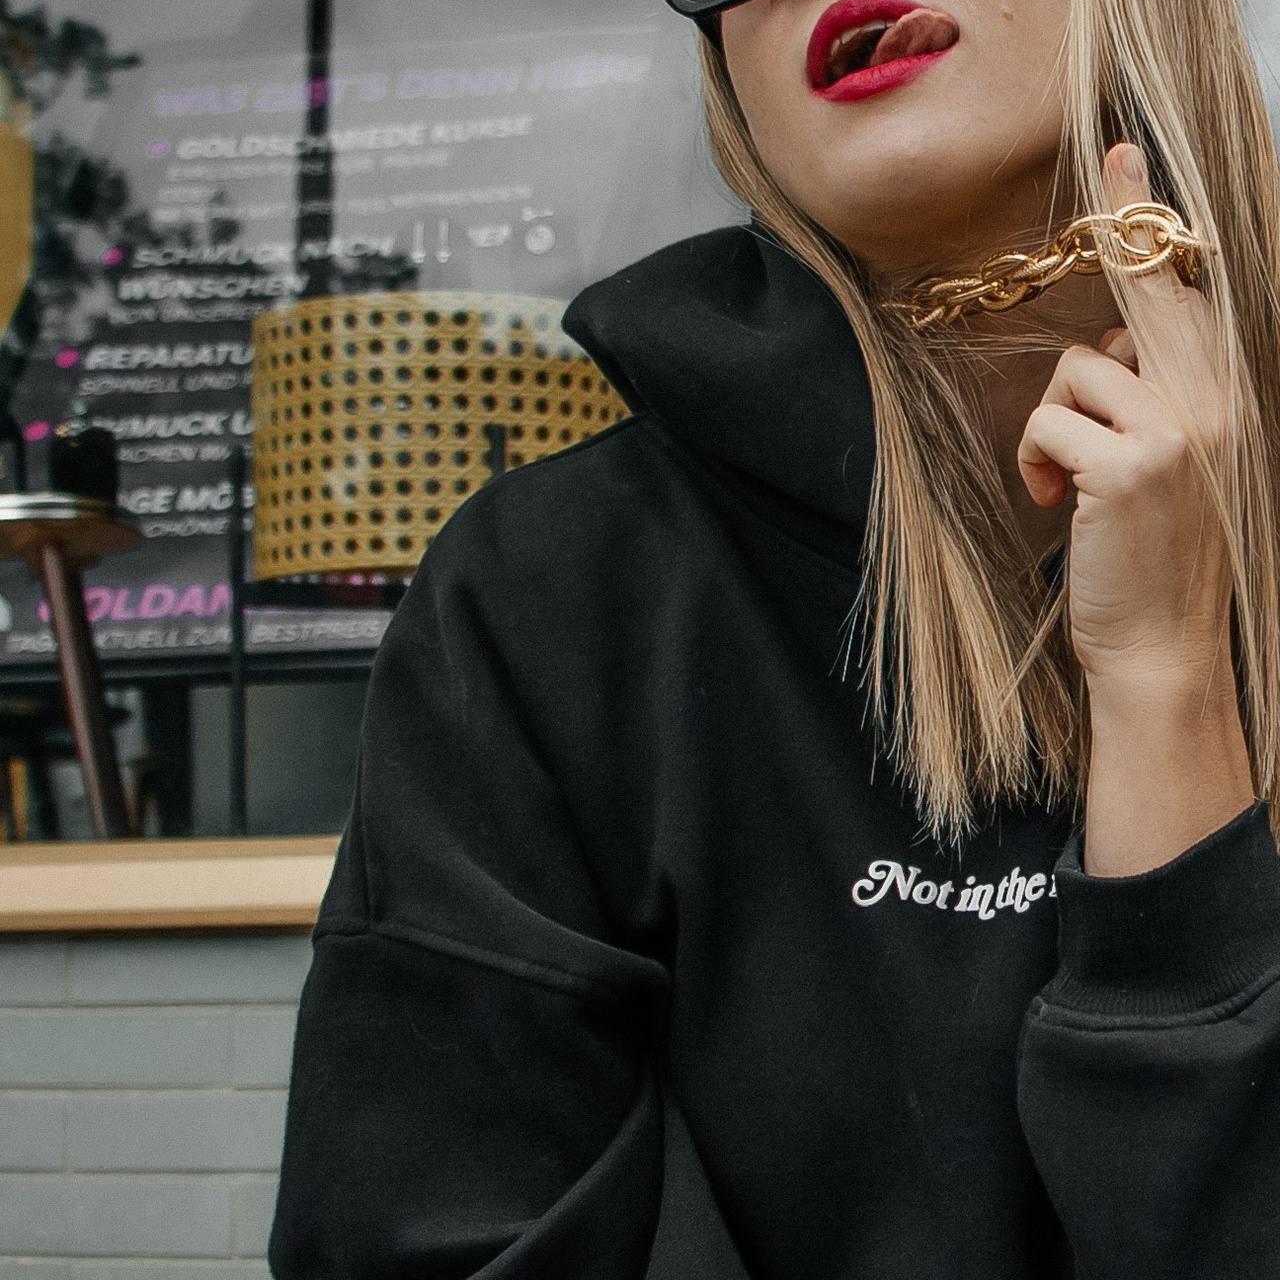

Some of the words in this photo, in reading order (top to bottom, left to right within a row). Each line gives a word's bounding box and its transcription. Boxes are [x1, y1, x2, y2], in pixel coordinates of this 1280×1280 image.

[852, 859, 954, 909] Not
[953, 876, 997, 920] in
[996, 866, 1047, 913] the
